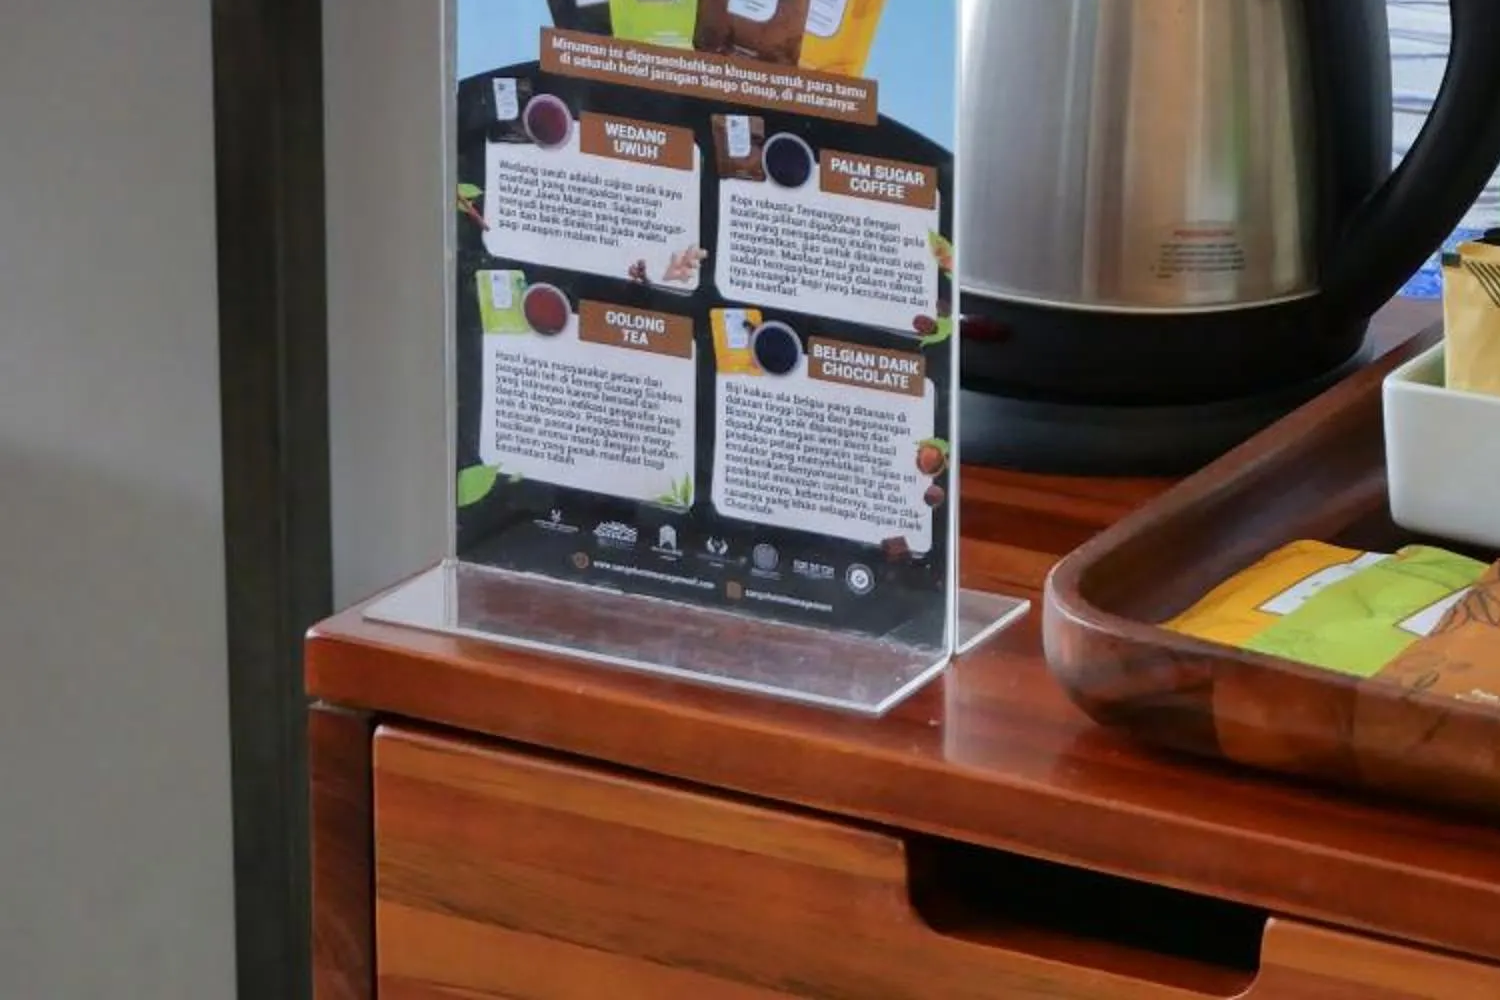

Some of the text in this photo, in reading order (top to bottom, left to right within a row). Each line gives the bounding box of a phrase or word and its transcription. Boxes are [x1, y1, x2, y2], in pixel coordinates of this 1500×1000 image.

[552, 35, 607, 57] Minuman
[725, 64, 768, 83] khusus
[769, 71, 803, 89] untuk
[806, 79, 833, 96] para
[835, 82, 867, 100] tamu
[559, 50, 571, 66] di
[618, 60, 649, 79] hotel
[649, 65, 699, 88] jaringan
[700, 74, 738, 95] Sango
[740, 80, 779, 102] Group,
[781, 87, 794, 103] di
[605, 124, 667, 144] WEDANG
[613, 141, 659, 160] UWUH
[831, 157, 925, 185] PALM SUGAR
[849, 177, 906, 199] COFFEE
[605, 311, 666, 332] OOLONG
[622, 328, 649, 346] TEA
[813, 344, 919, 374] BELGIAN DARK
[822, 361, 911, 389] CHOCOLATE
